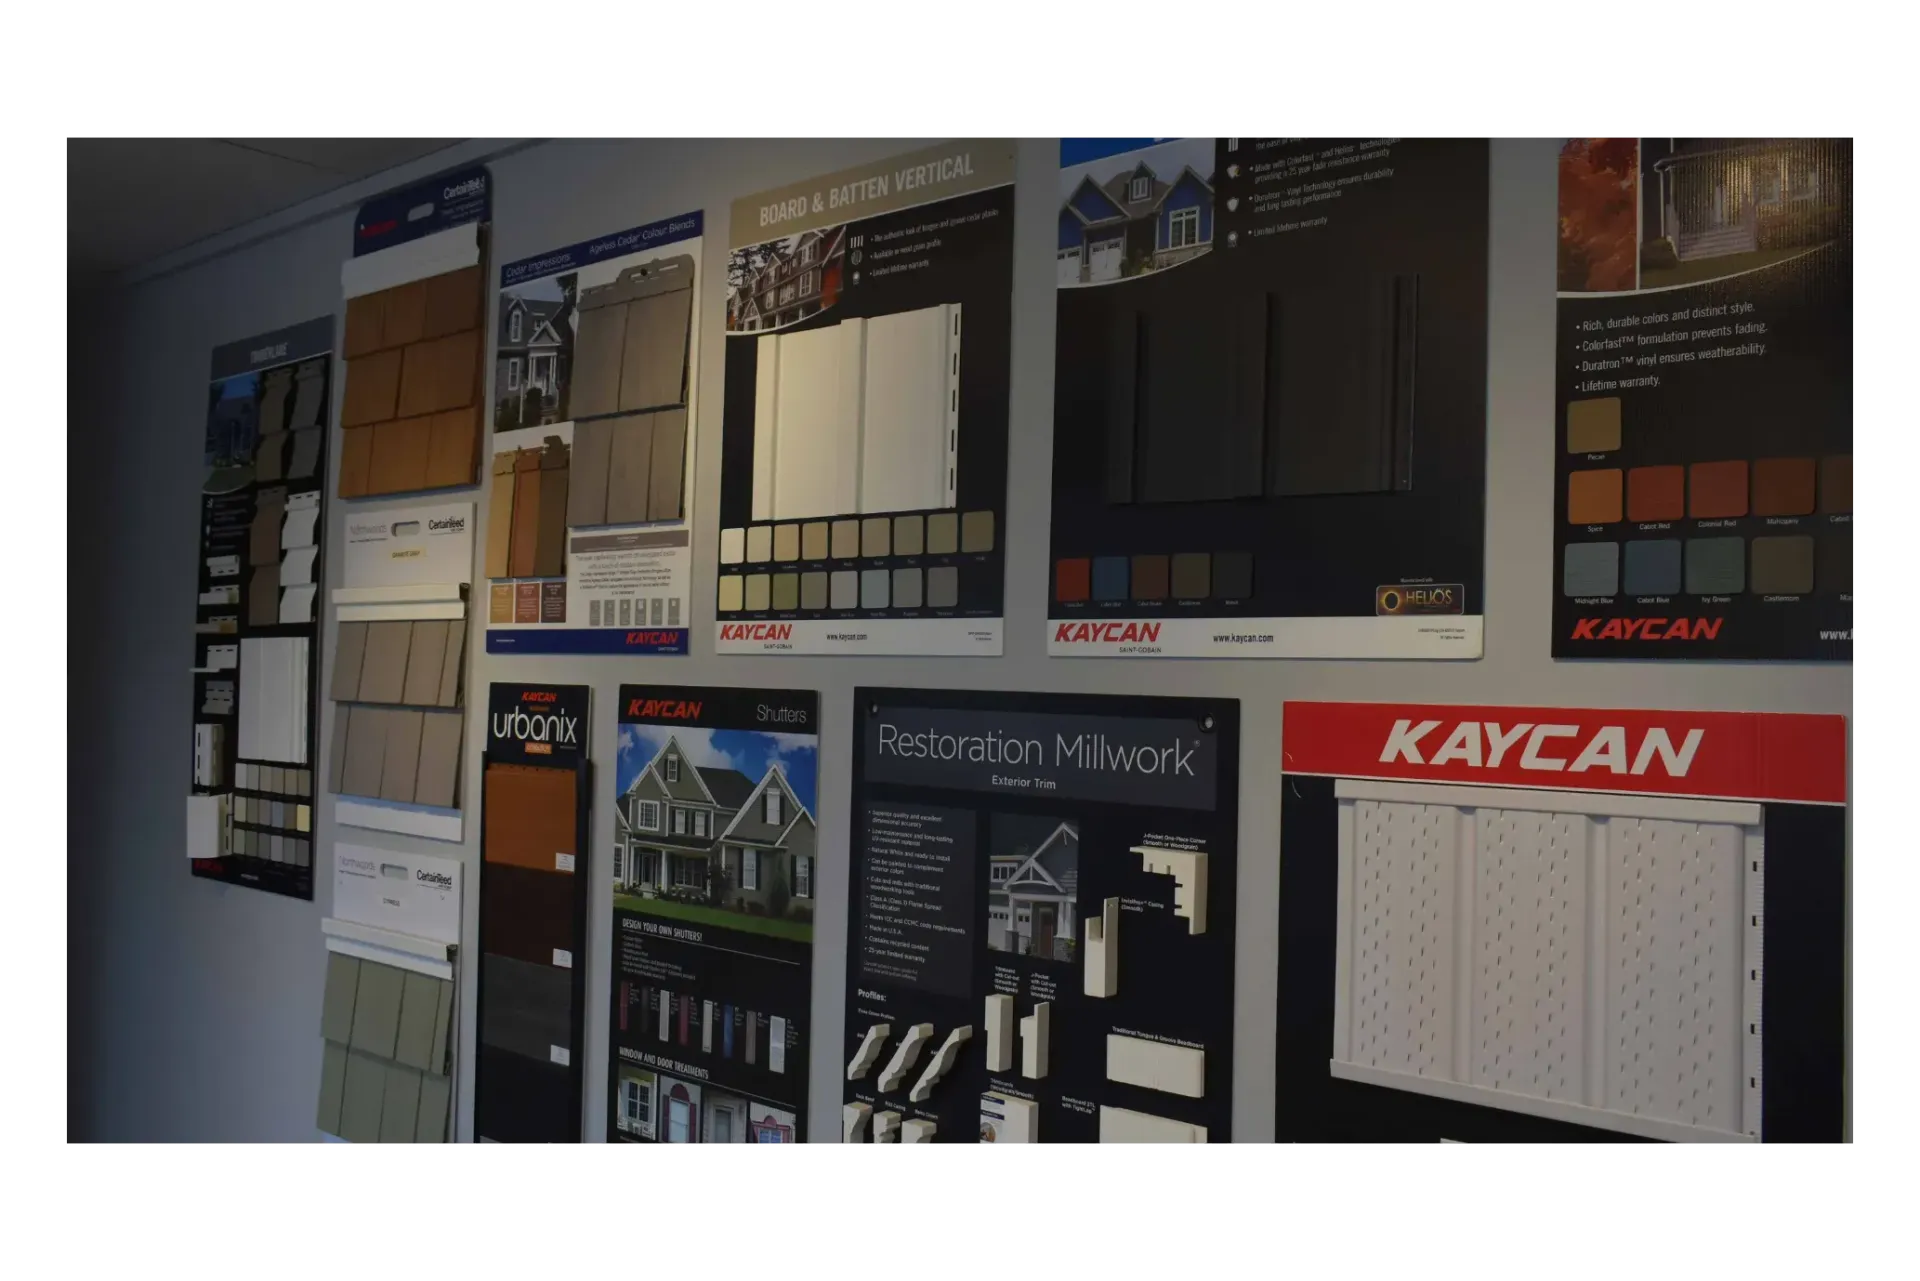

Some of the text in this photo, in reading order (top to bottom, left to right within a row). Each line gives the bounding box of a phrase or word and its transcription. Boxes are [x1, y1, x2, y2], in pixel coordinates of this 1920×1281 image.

[1254, 164, 1271, 172] Made
[1273, 160, 1286, 168] with
[1254, 171, 1282, 184] providing
[1298, 166, 1311, 175] year
[1328, 155, 1359, 168] resistance
[1361, 148, 1390, 161] warranty
[1337, 175, 1362, 185] ensures
[1363, 168, 1394, 180] durability
[760, 153, 974, 227] BOARD & BATTEN VERTICAL
[1254, 190, 1341, 213] and long lasting performance
[669, 218, 696, 234] Blends
[1254, 216, 1328, 237] Limited warranty
[1583, 301, 1755, 332] Rich, durable colors and distinct style.
[1637, 330, 1688, 345] formulation
[1692, 325, 1731, 341] prevents
[1735, 322, 1768, 334] fading.
[1636, 353, 1657, 366] vinyl
[1659, 352, 1695, 364] ensures
[1697, 342, 1767, 359] weatherability.
[1582, 376, 1660, 391] Lifetime warranty.
[1587, 525, 1603, 533] Spice
[1406, 589, 1453, 605] HELIOS
[626, 631, 679, 645] KAYCAN
[720, 624, 792, 640] KAYCAN
[826, 633, 868, 641] www.kaycan.com
[1055, 622, 1161, 642] KAYCAN
[1571, 617, 1724, 640] KAYCAN
[1213, 634, 1274, 644] www.kaycan.com
[521, 691, 558, 703] KAYCAN
[628, 698, 703, 720] KAYCAN
[756, 704, 807, 724] Shutters
[493, 705, 578, 744] urbanix
[879, 723, 1043, 766] Restoration
[1378, 719, 1704, 777] KAYCAN
[992, 775, 1056, 790] Exterior Trim
[417, 870, 452, 885] CertainTeed
[623, 918, 703, 941] DESIGN YOUR OWN SHUTTERS!
[858, 988, 886, 1002] Profiles:
[1112, 1026, 1136, 1035] Traditional
[619, 1046, 709, 1079] WINDOW AND DOOR TREATMENTS
